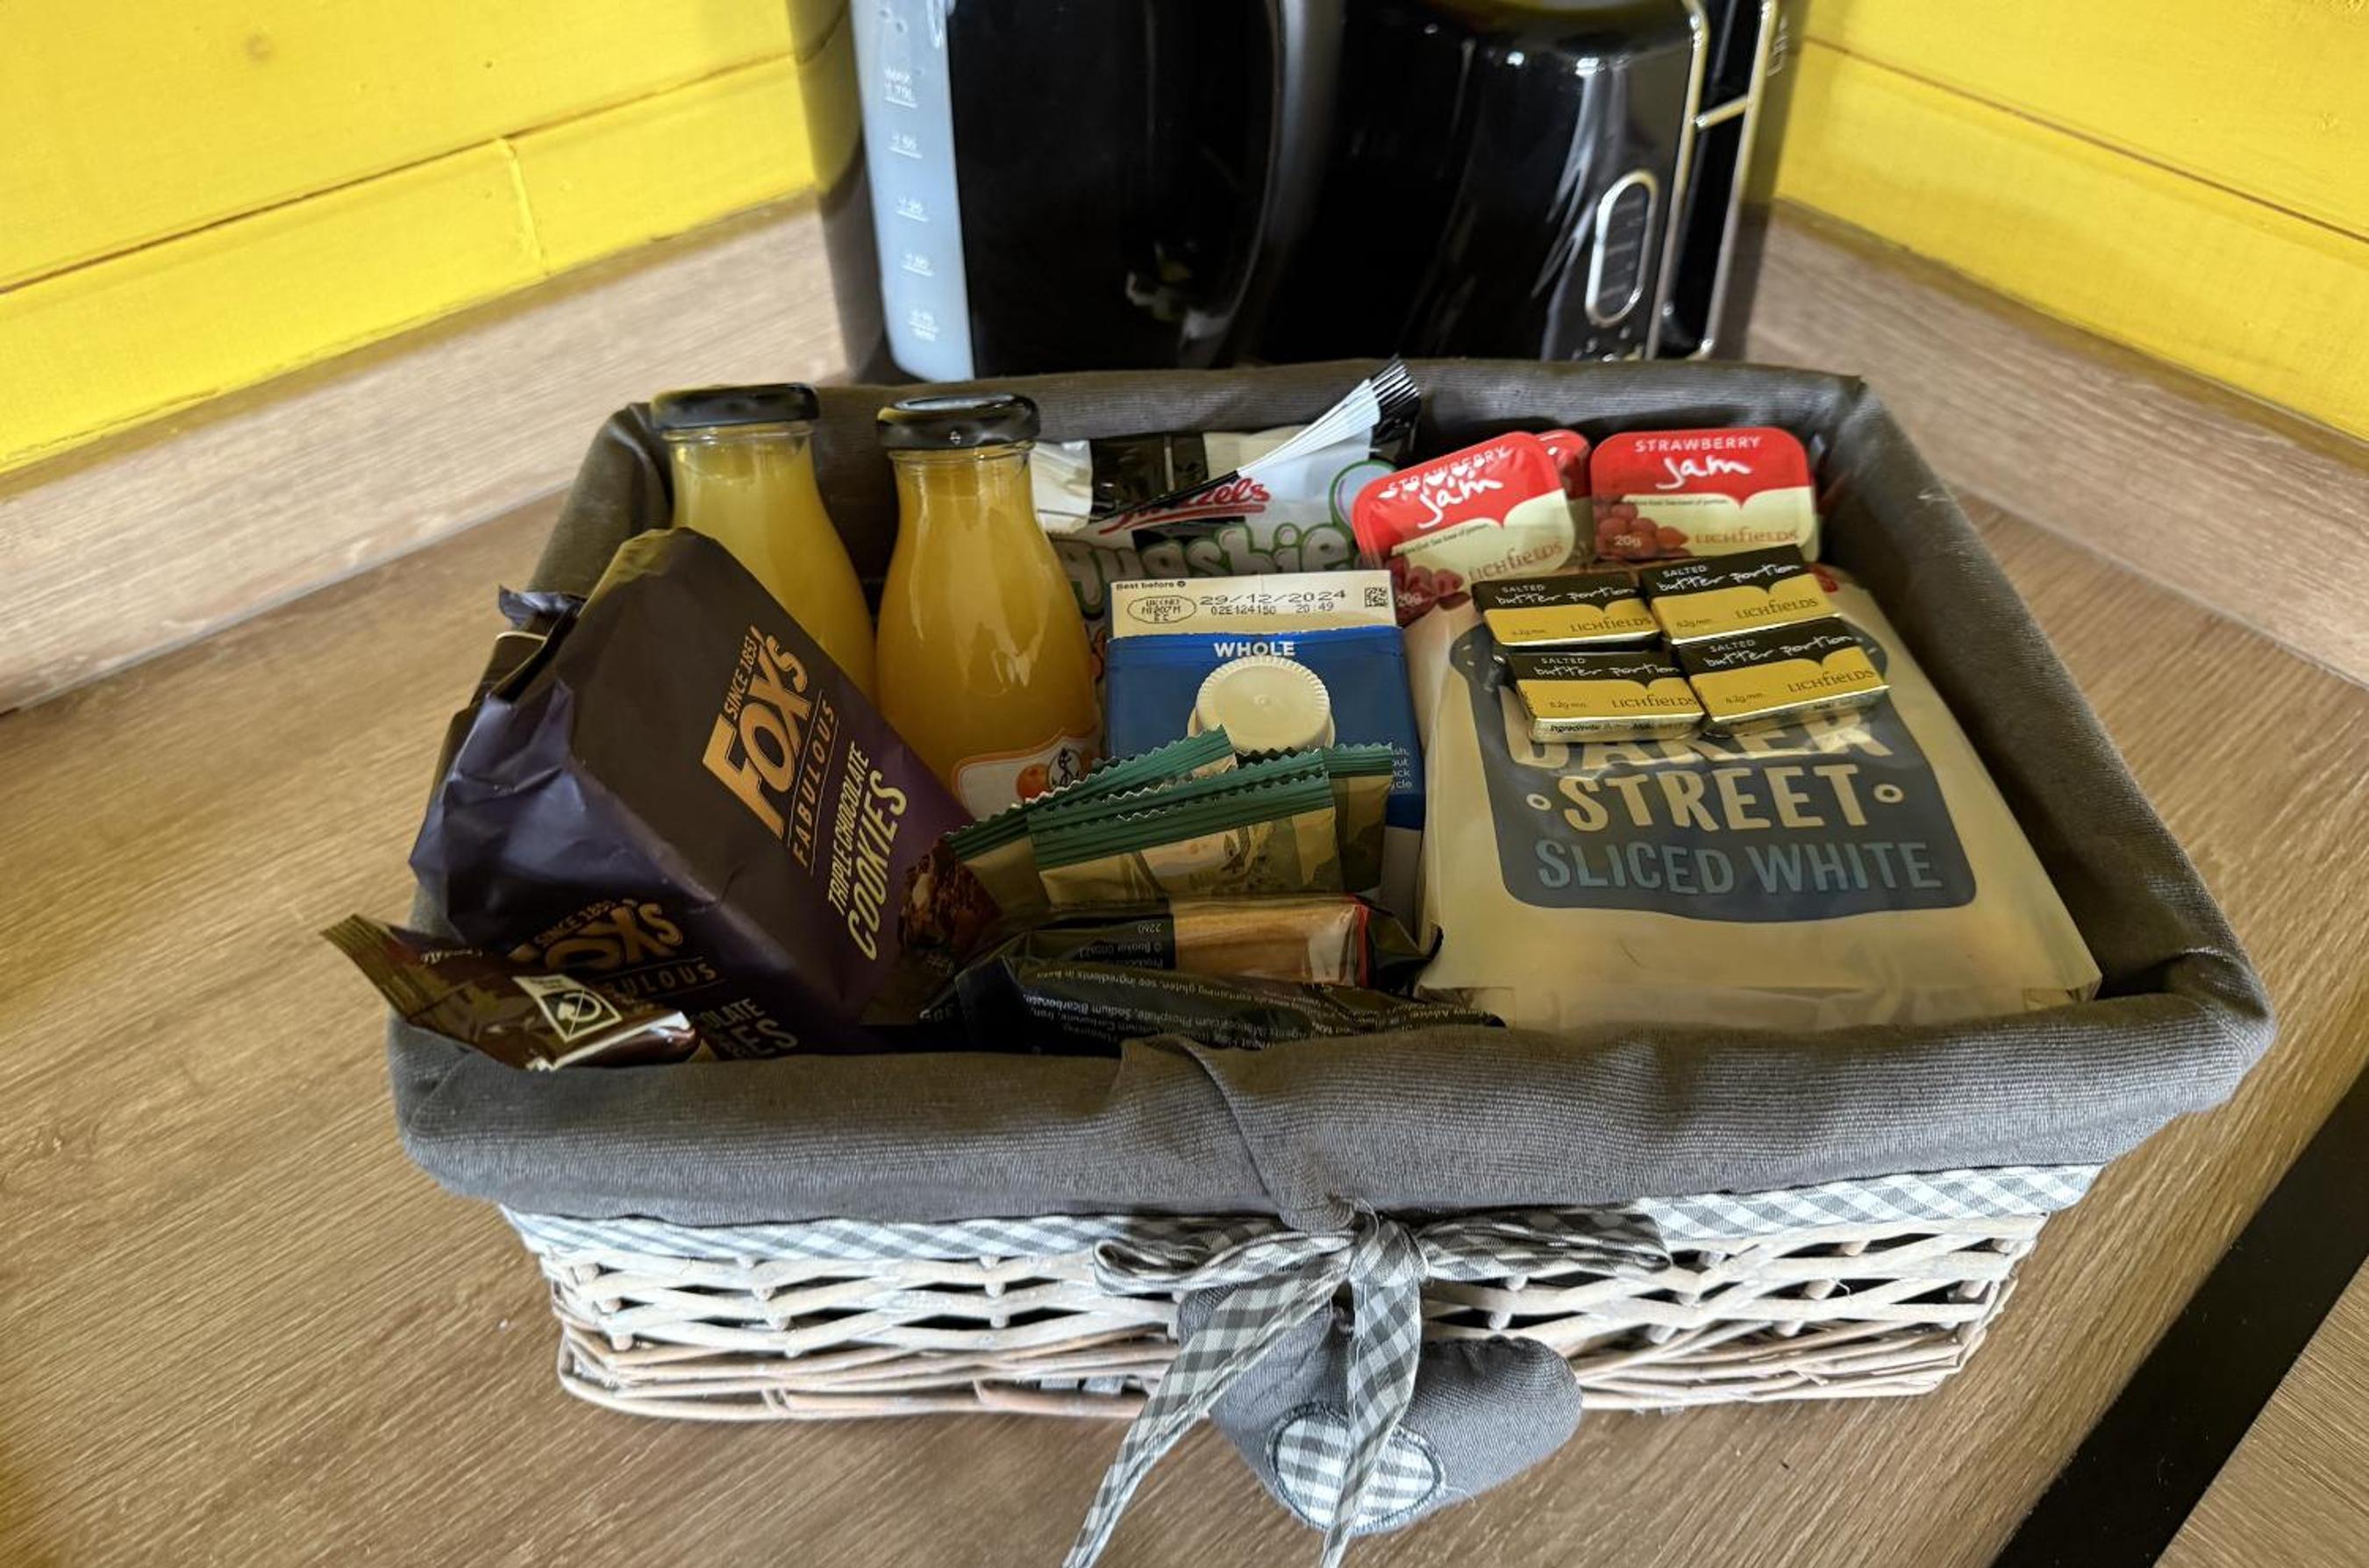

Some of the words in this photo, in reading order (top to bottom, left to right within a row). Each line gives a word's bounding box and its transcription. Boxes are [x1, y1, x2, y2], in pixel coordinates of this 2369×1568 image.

[1635, 437, 1761, 453] STRAWBERRY
[1614, 535, 1643, 548] 20g
[1663, 564, 1709, 579] SALTED
[1502, 583, 1546, 594] SALTED
[1656, 574, 1727, 592] butter
[1200, 589, 1345, 606] 29/12/2024
[1495, 592, 1563, 606] butter
[1214, 641, 1296, 658] WHOLE
[1709, 640, 1756, 653] SALTED
[1702, 649, 1774, 667] butter
[1534, 664, 1603, 676] butter
[724, 667, 748, 721] SINCE
[793, 699, 834, 868] FABULOUS
[835, 741, 869, 851] CHOCOLATE
[1559, 763, 1870, 832] STREET
[848, 769, 908, 960] COOKIES
[1535, 838, 1736, 895] SLICED
[1745, 841, 1943, 895] WHITE
[829, 841, 853, 916] TRIPLE
[507, 898, 684, 970] OX'S
